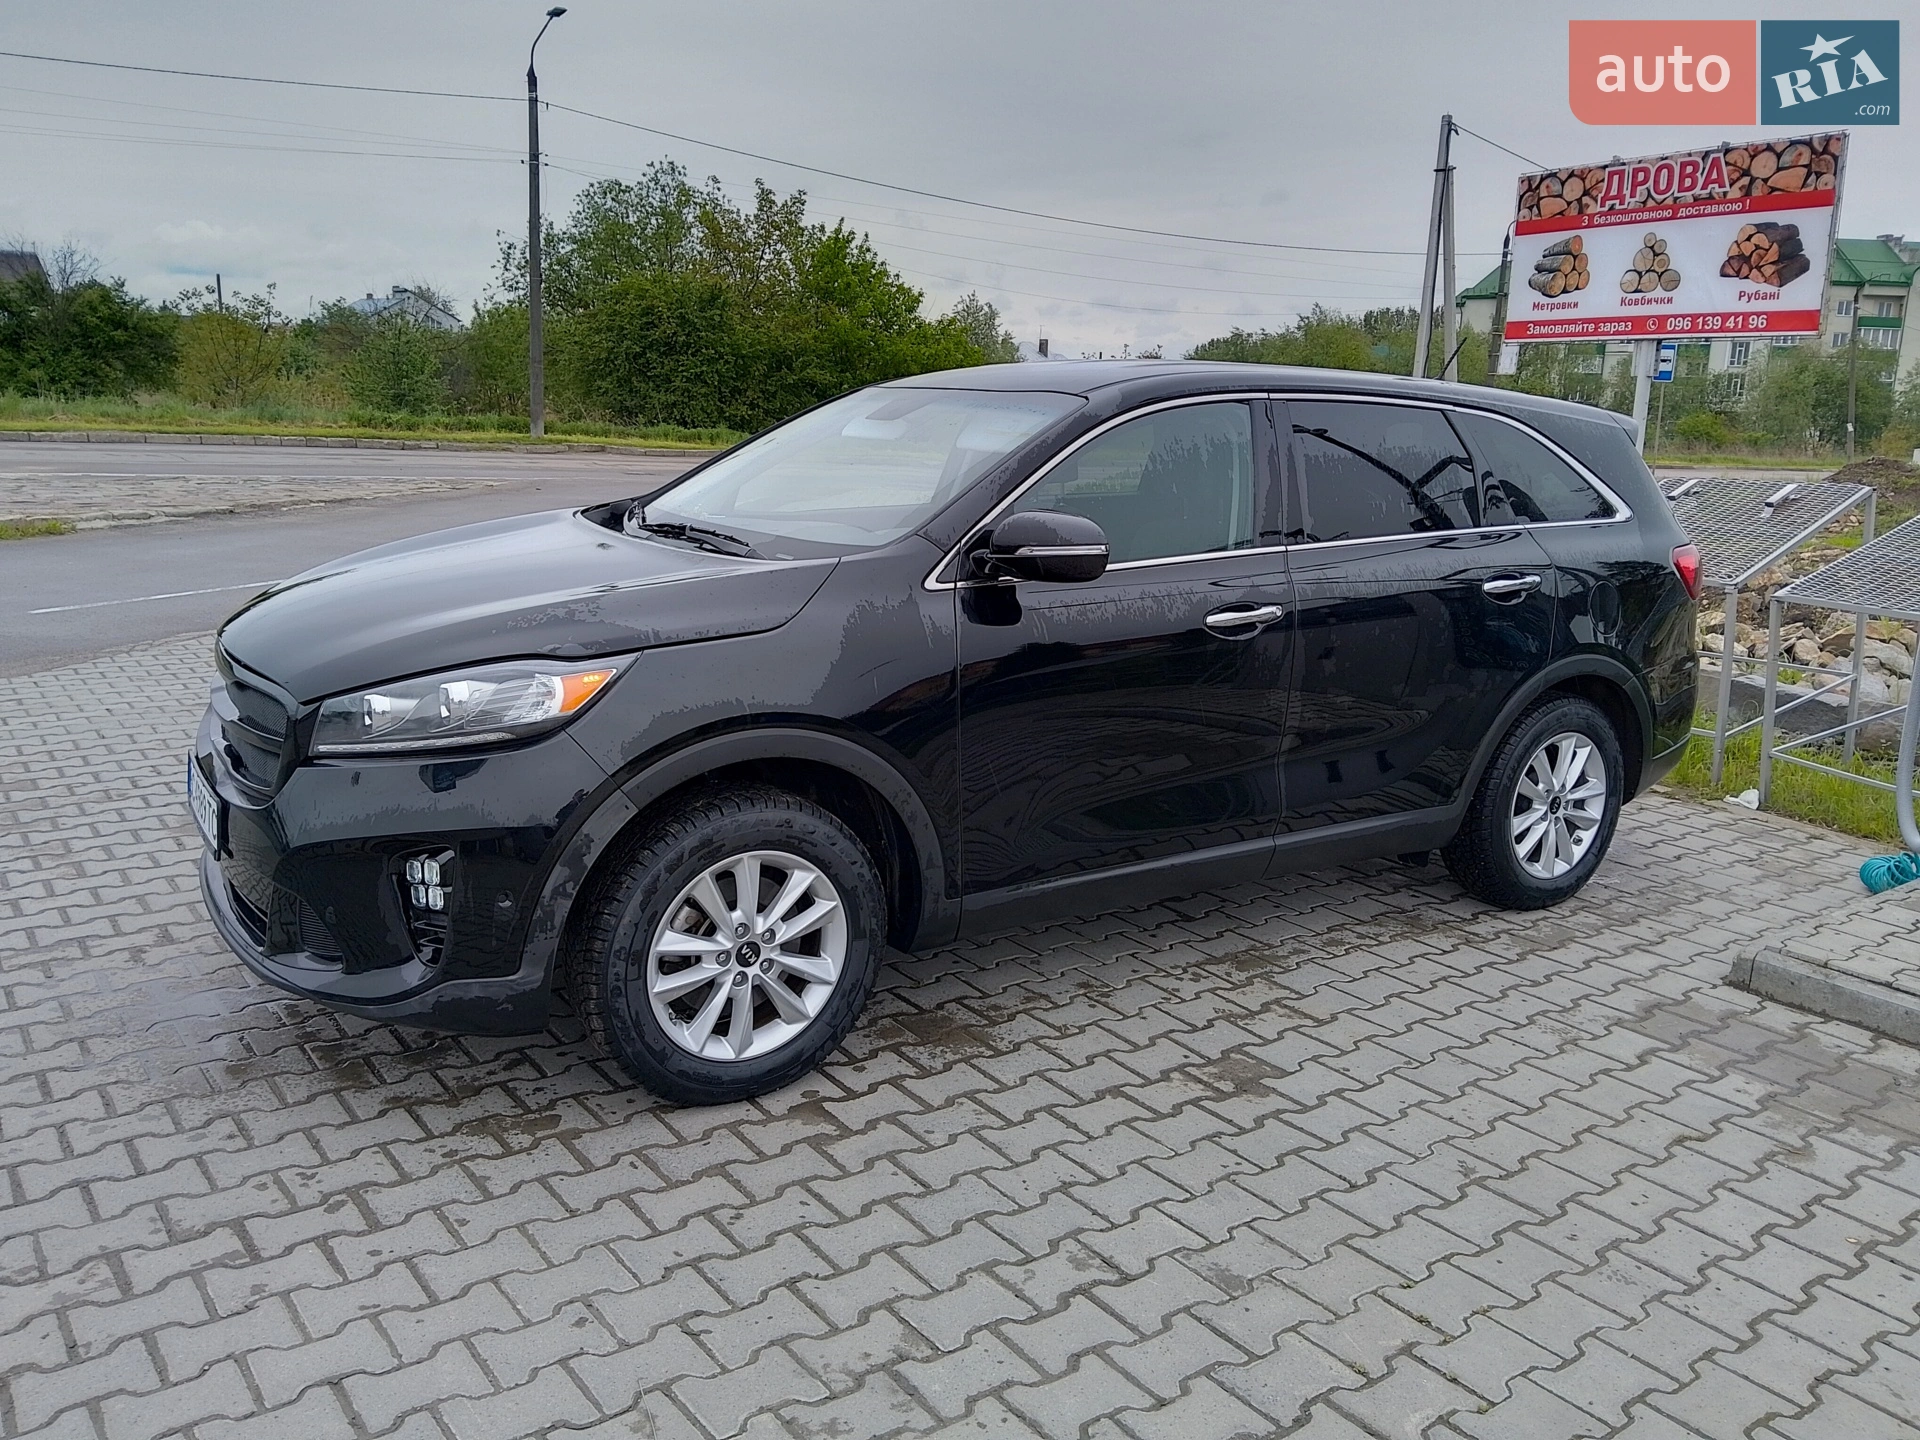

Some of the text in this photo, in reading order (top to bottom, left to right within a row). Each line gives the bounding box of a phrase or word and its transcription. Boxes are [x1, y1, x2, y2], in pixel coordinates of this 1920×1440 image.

[1599, 154, 1729, 210] ДРОВА
[1593, 208, 1673, 225] безкоштовною
[1677, 201, 1743, 218] доставкою
[1620, 295, 1674, 307] Ковбички
[1738, 289, 1780, 303] Рубані
[1532, 301, 1579, 312] Метровки
[1526, 314, 1768, 335] Замовляйте зараз 096 139 41 96
[741, 944, 758, 964] KIA
